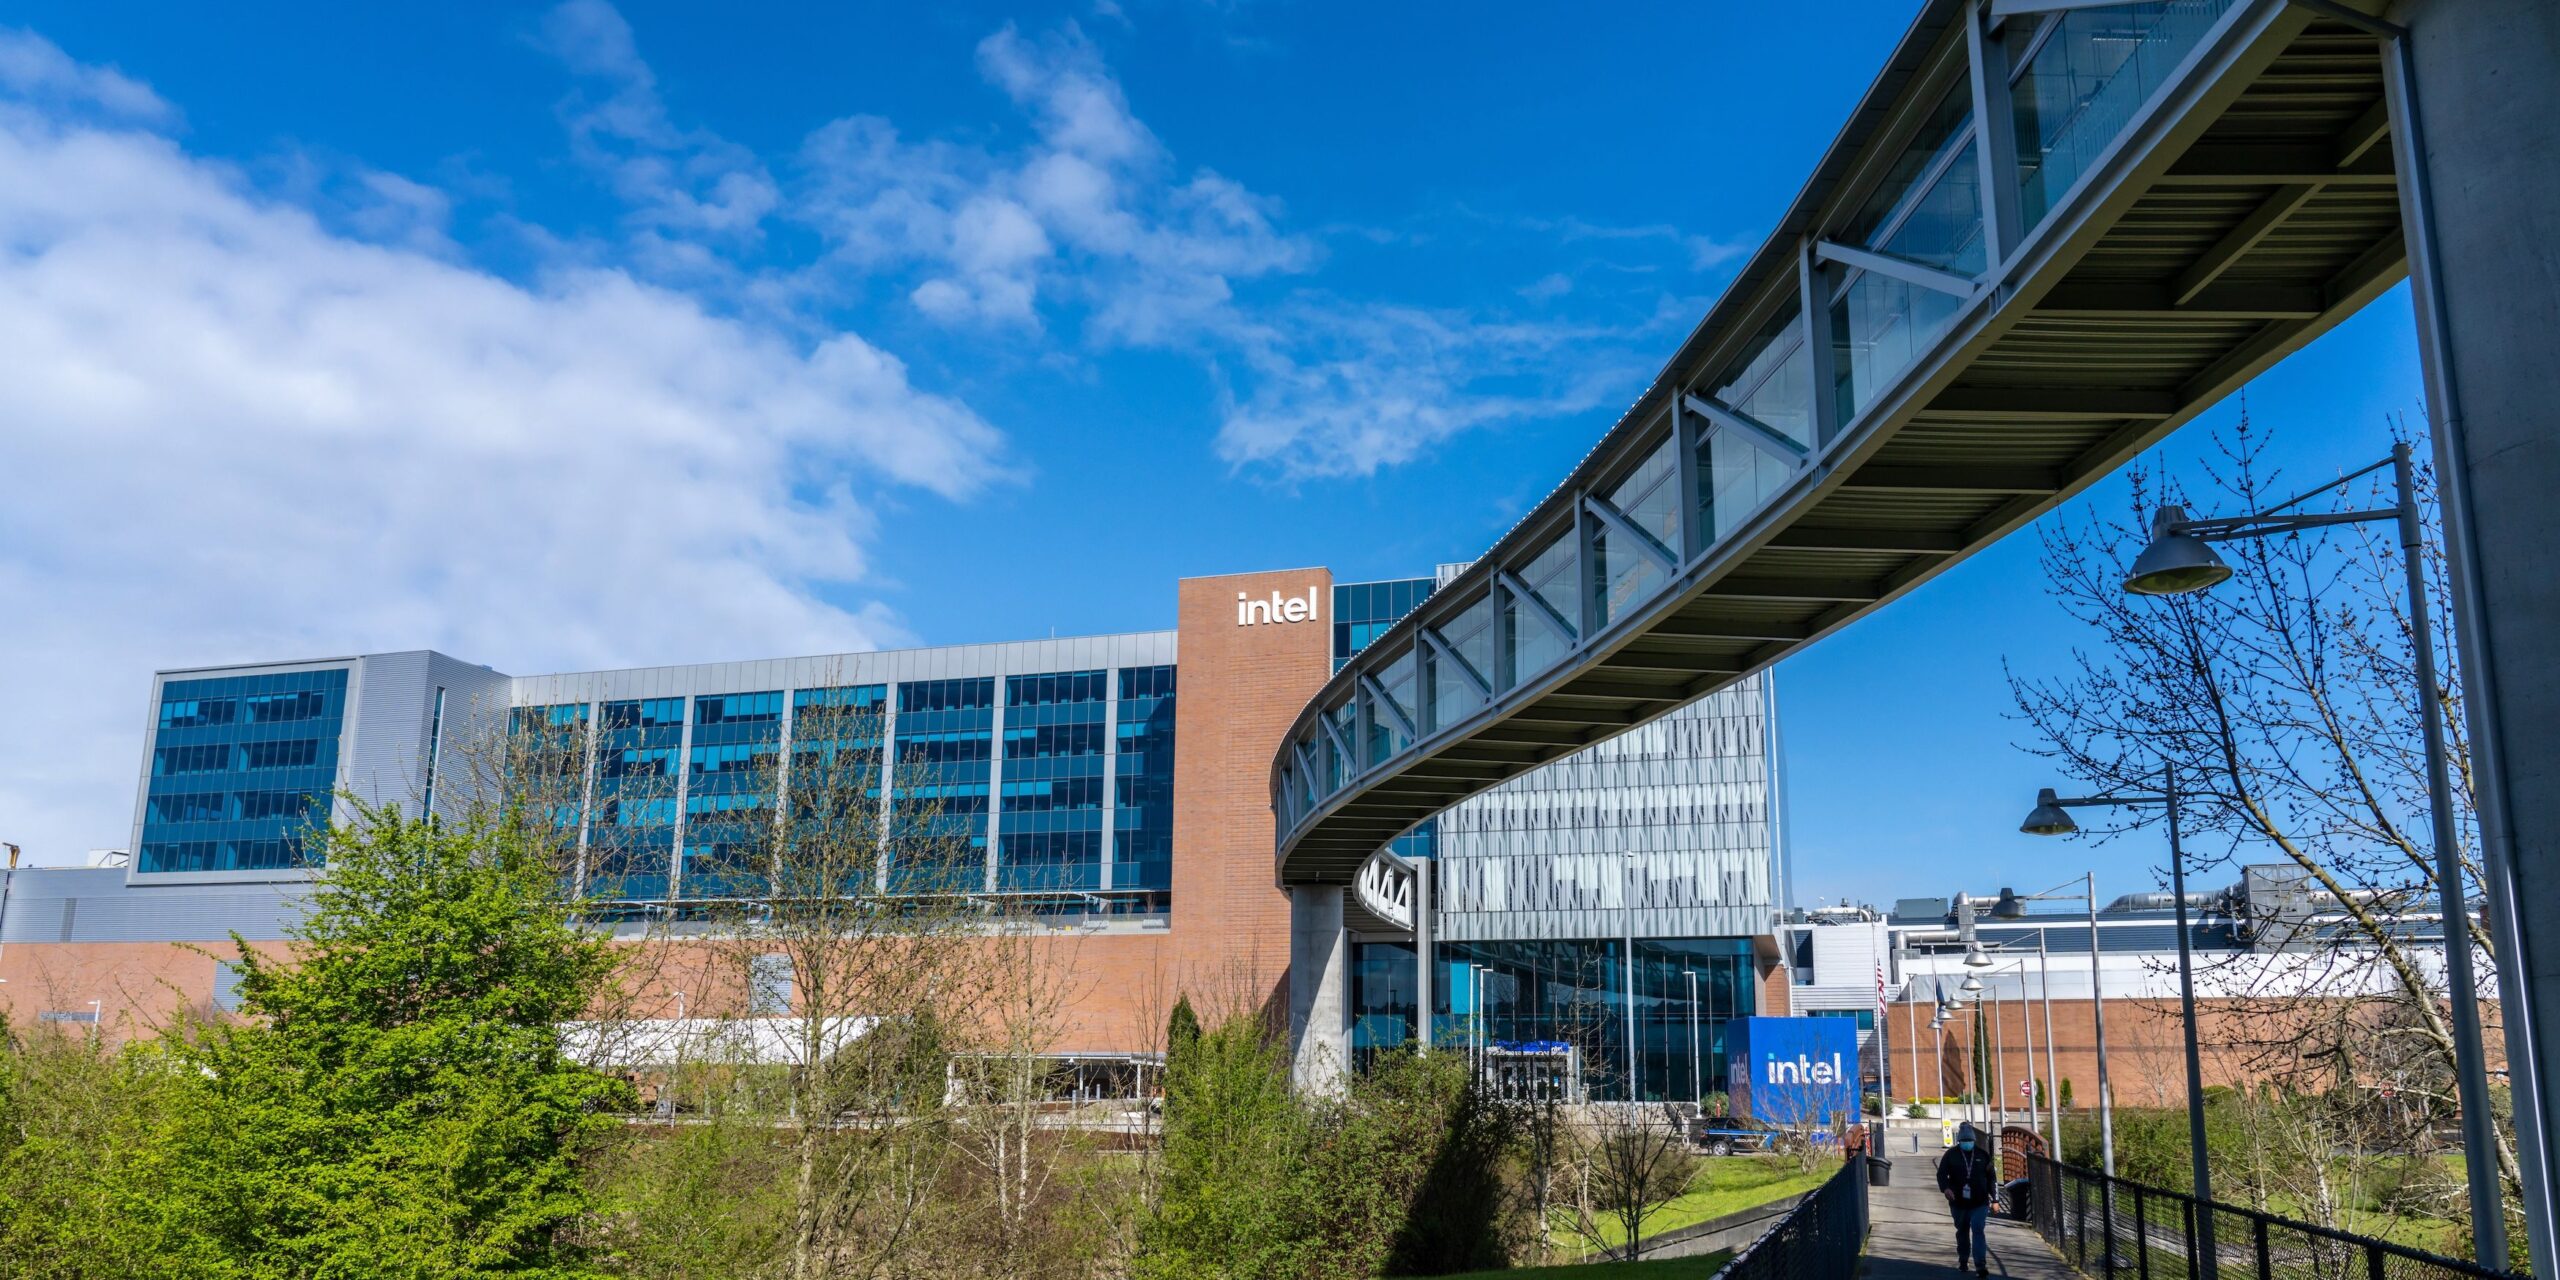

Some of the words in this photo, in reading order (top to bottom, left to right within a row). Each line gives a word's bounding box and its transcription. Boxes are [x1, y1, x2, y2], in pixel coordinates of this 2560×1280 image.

[1238, 586, 1318, 626] intel
[1730, 1053, 1748, 1084] intel
[1767, 1052, 1842, 1084] intel
